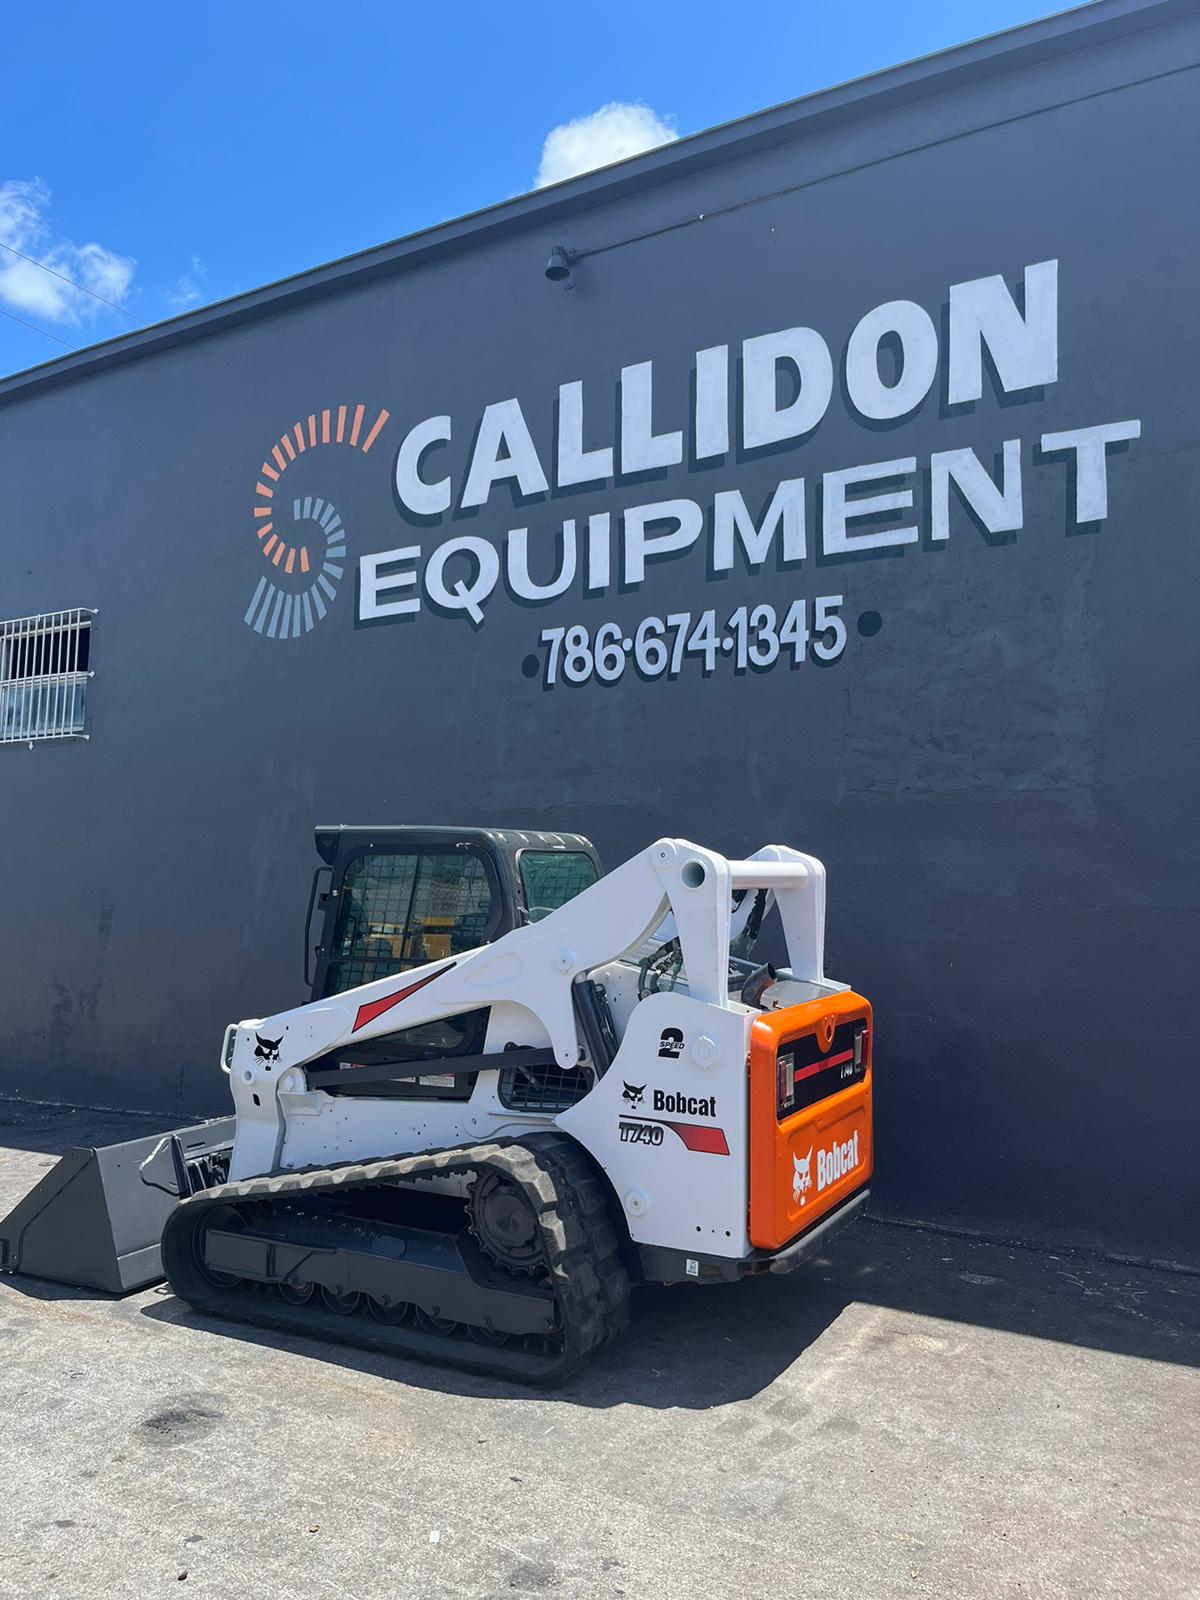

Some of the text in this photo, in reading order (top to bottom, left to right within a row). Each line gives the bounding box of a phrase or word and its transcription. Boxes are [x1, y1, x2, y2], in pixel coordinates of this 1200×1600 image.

[396, 259, 1058, 515] CALLIDON
[359, 419, 1141, 625] EQUIPMENT
[658, 1027, 684, 1059] 2
[660, 1040, 685, 1050] SPEED
[653, 1089, 717, 1118] Bobcat
[619, 1121, 664, 1147] T740
[816, 1129, 859, 1192] Bobcat
